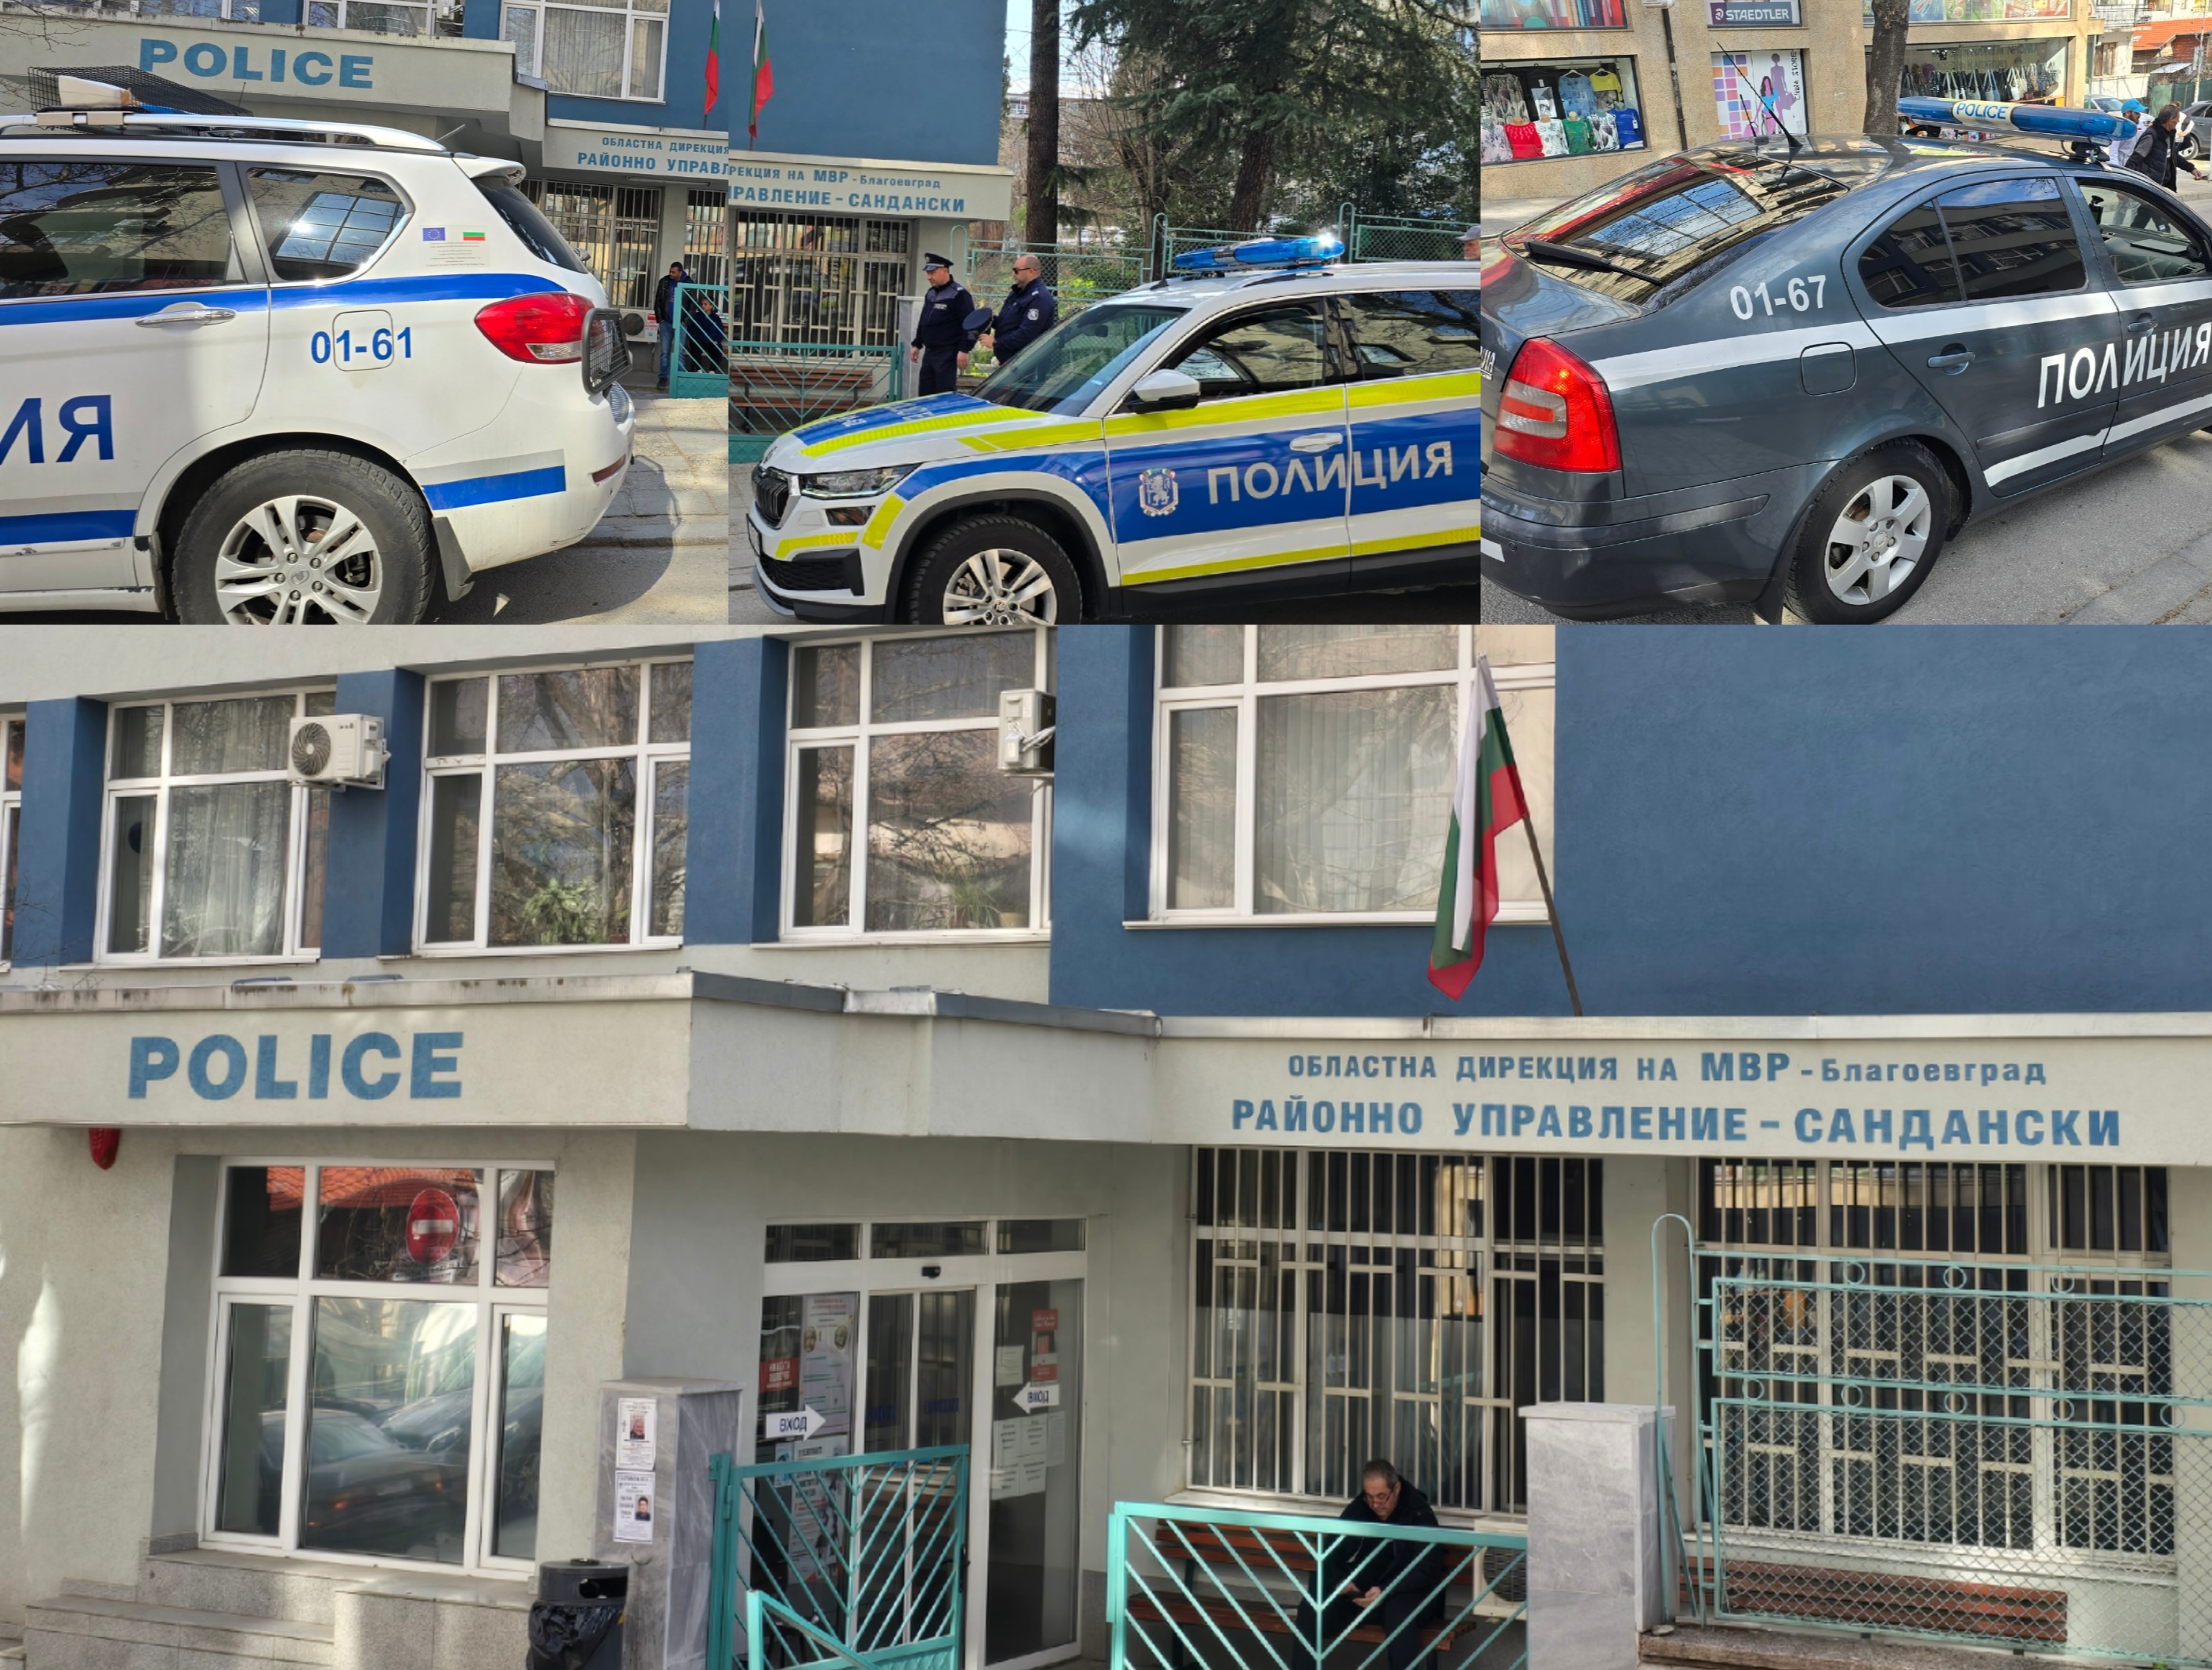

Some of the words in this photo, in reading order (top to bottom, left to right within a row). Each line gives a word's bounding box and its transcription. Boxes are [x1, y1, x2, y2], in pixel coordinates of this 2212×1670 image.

[1726, 9, 1790, 20] STAEDTLER
[139, 38, 375, 89] POLICE
[1956, 103, 2008, 120] POLICE
[603, 137, 663, 150] ОБЛАСТНА
[577, 151, 657, 171] РАЙОННО
[787, 170, 805, 180] НА
[813, 169, 849, 183] МВР
[849, 193, 965, 212] САНДАНСКИ
[1730, 275, 1826, 320] 01-67
[310, 326, 412, 364] 01-61
[2037, 322, 2212, 408] ПОЛИЦИЯ
[1207, 440, 1454, 504] ПОЛИЦИЯ
[129, 1031, 464, 1100] POLICE
[1289, 1055, 1435, 1078] ОБЛАСТНА
[1456, 1056, 1617, 1082] ДИРЕКЦИЯ
[1638, 1058, 1677, 1081] НА
[1701, 1052, 1790, 1082] МВР
[1232, 1095, 1423, 1136] РАЙОННО
[1453, 1103, 1747, 1143] УПРАВЛЕНИЕ
[1795, 1107, 2120, 1151] САНДАНСКИ
[779, 1416, 807, 1433] ВХОД
